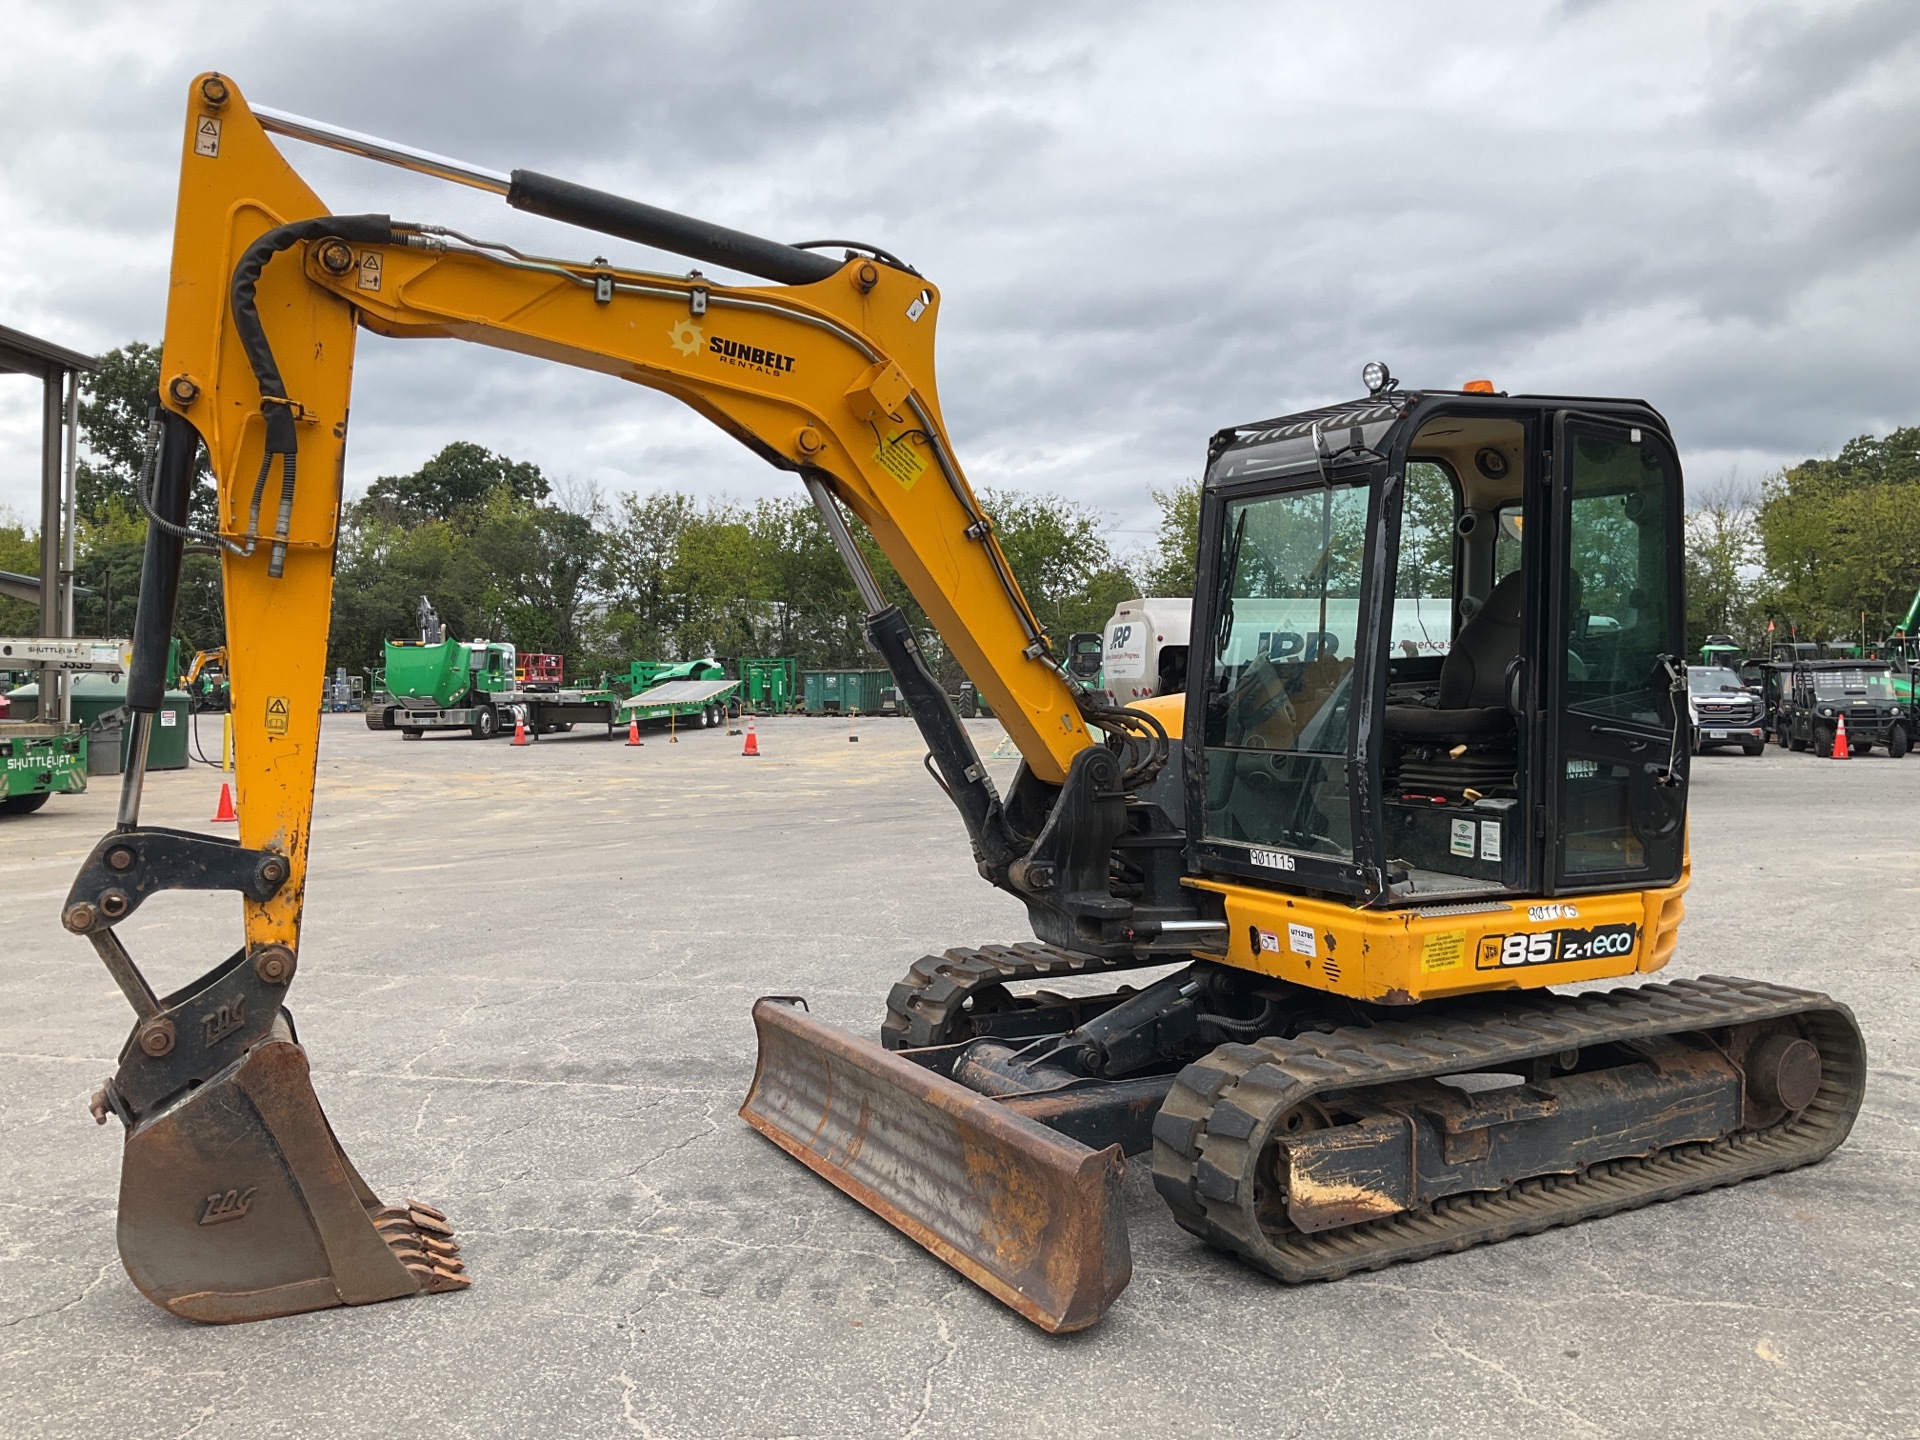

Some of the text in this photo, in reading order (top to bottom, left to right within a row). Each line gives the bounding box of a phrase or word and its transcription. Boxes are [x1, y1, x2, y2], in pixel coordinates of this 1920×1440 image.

[709, 336, 796, 373] SUNBELT
[719, 355, 780, 377] RENTALS
[7, 754, 71, 771] SHUTTLELIFT
[1250, 849, 1294, 870] 901115
[1484, 944, 1499, 960] JCB
[1501, 932, 1553, 965] 85
